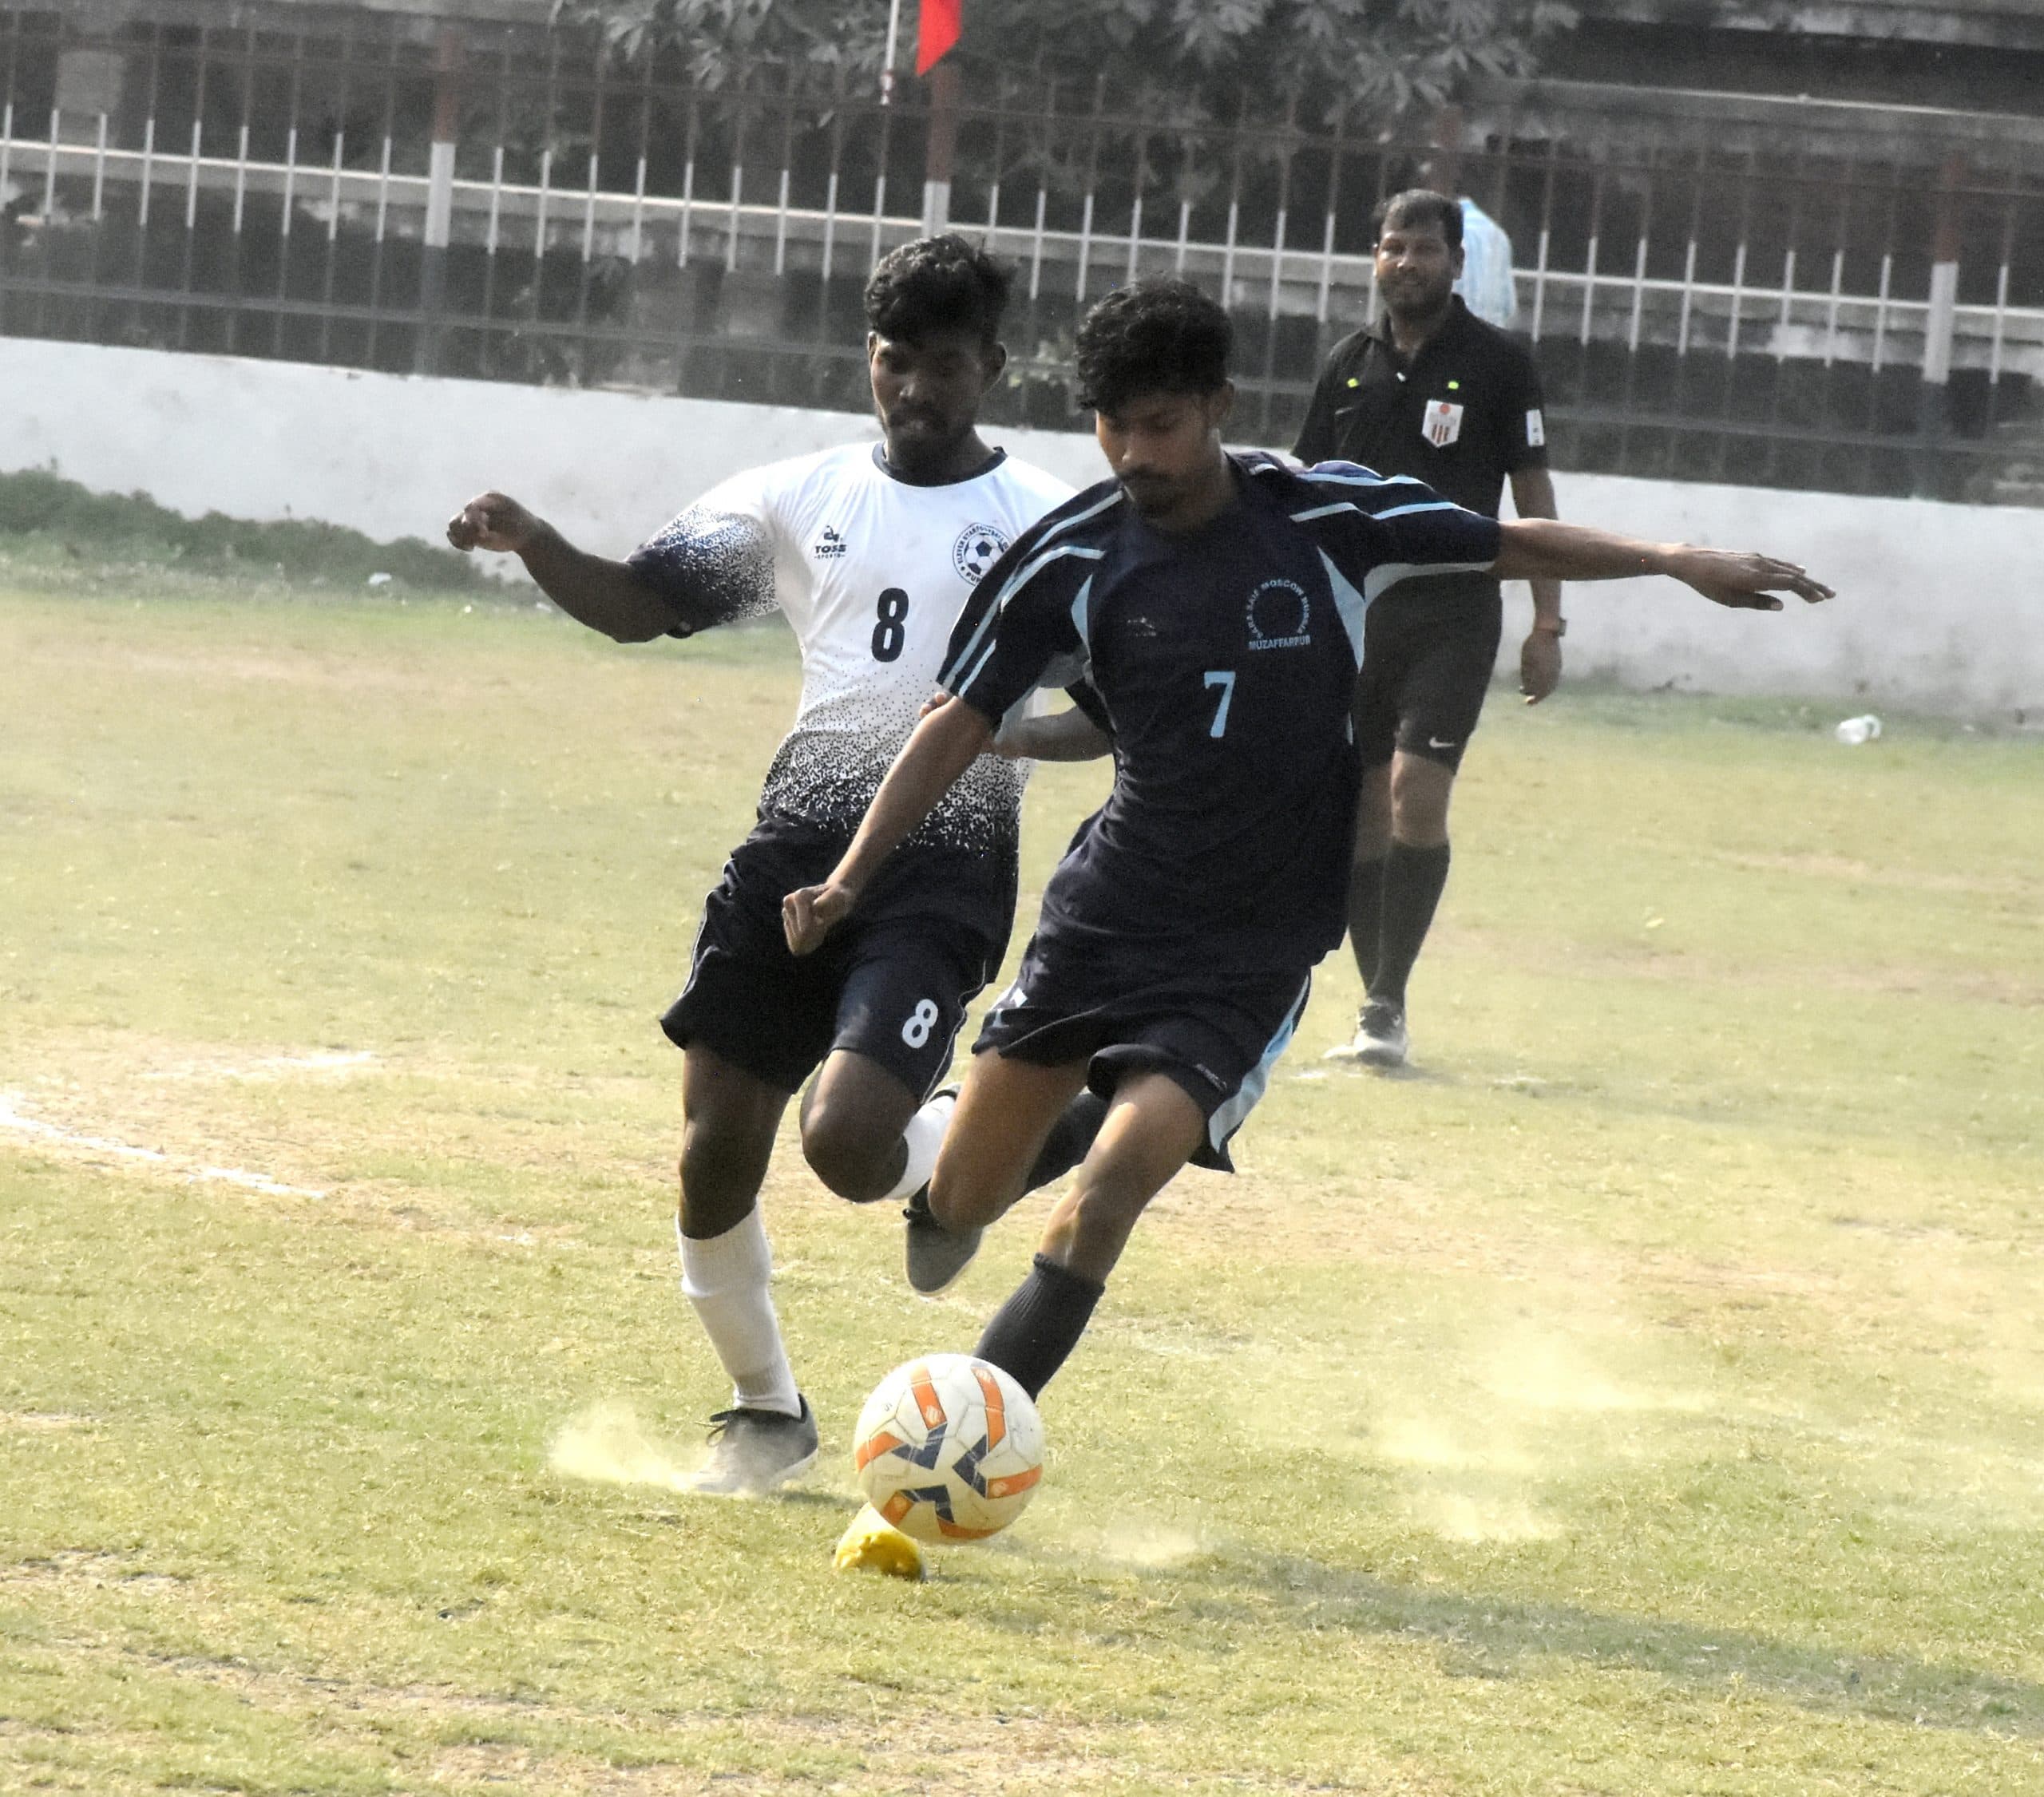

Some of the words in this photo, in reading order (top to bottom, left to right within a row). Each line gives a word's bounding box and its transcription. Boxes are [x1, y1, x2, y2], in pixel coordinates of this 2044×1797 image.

[815, 544, 847, 554] TOSS
[871, 587, 909, 663] 8
[1248, 634, 1312, 651] MUZAFFARPUR
[1203, 671, 1236, 738] 7
[902, 998, 939, 1049] 8
